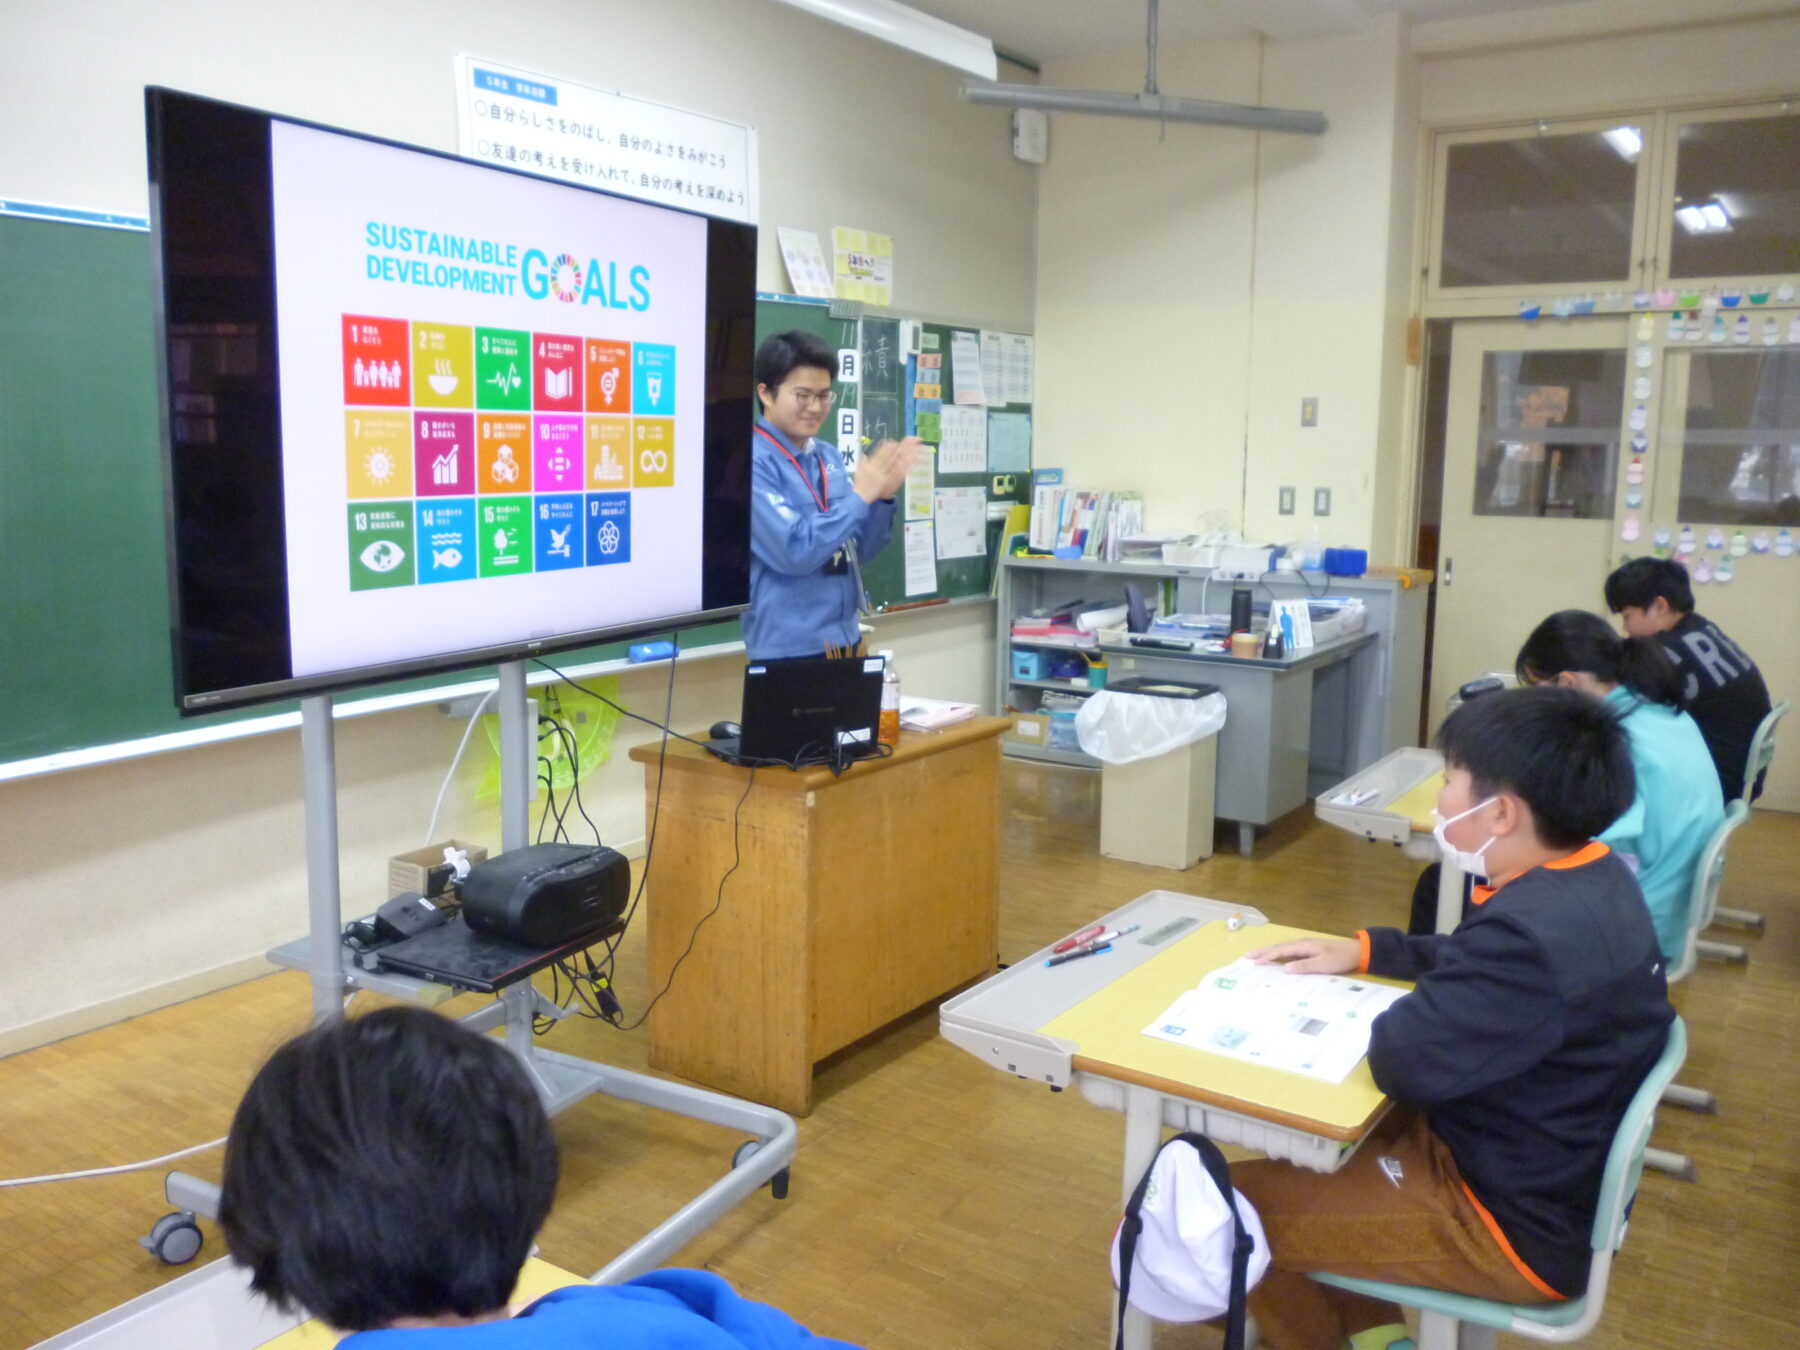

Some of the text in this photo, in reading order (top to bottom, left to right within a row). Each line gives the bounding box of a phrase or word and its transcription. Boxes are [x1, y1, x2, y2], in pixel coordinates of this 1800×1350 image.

[365, 221, 518, 269] SUSTAINABLE
[366, 254, 518, 297] DEVELOPMENT
[521, 247, 651, 313] GOALS
[351, 324, 359, 344] 1
[419, 330, 427, 349] 2
[481, 336, 490, 354] 3
[538, 341, 547, 359] 4
[589, 345, 598, 363] 5
[352, 419, 361, 439] 7
[421, 420, 429, 439] 8
[482, 421, 491, 439] 9
[539, 423, 551, 440] 10
[421, 508, 435, 528] 14
[483, 505, 495, 524] 15
[539, 502, 550, 521] 16
[590, 500, 600, 517] 17
[354, 512, 368, 532] 13
